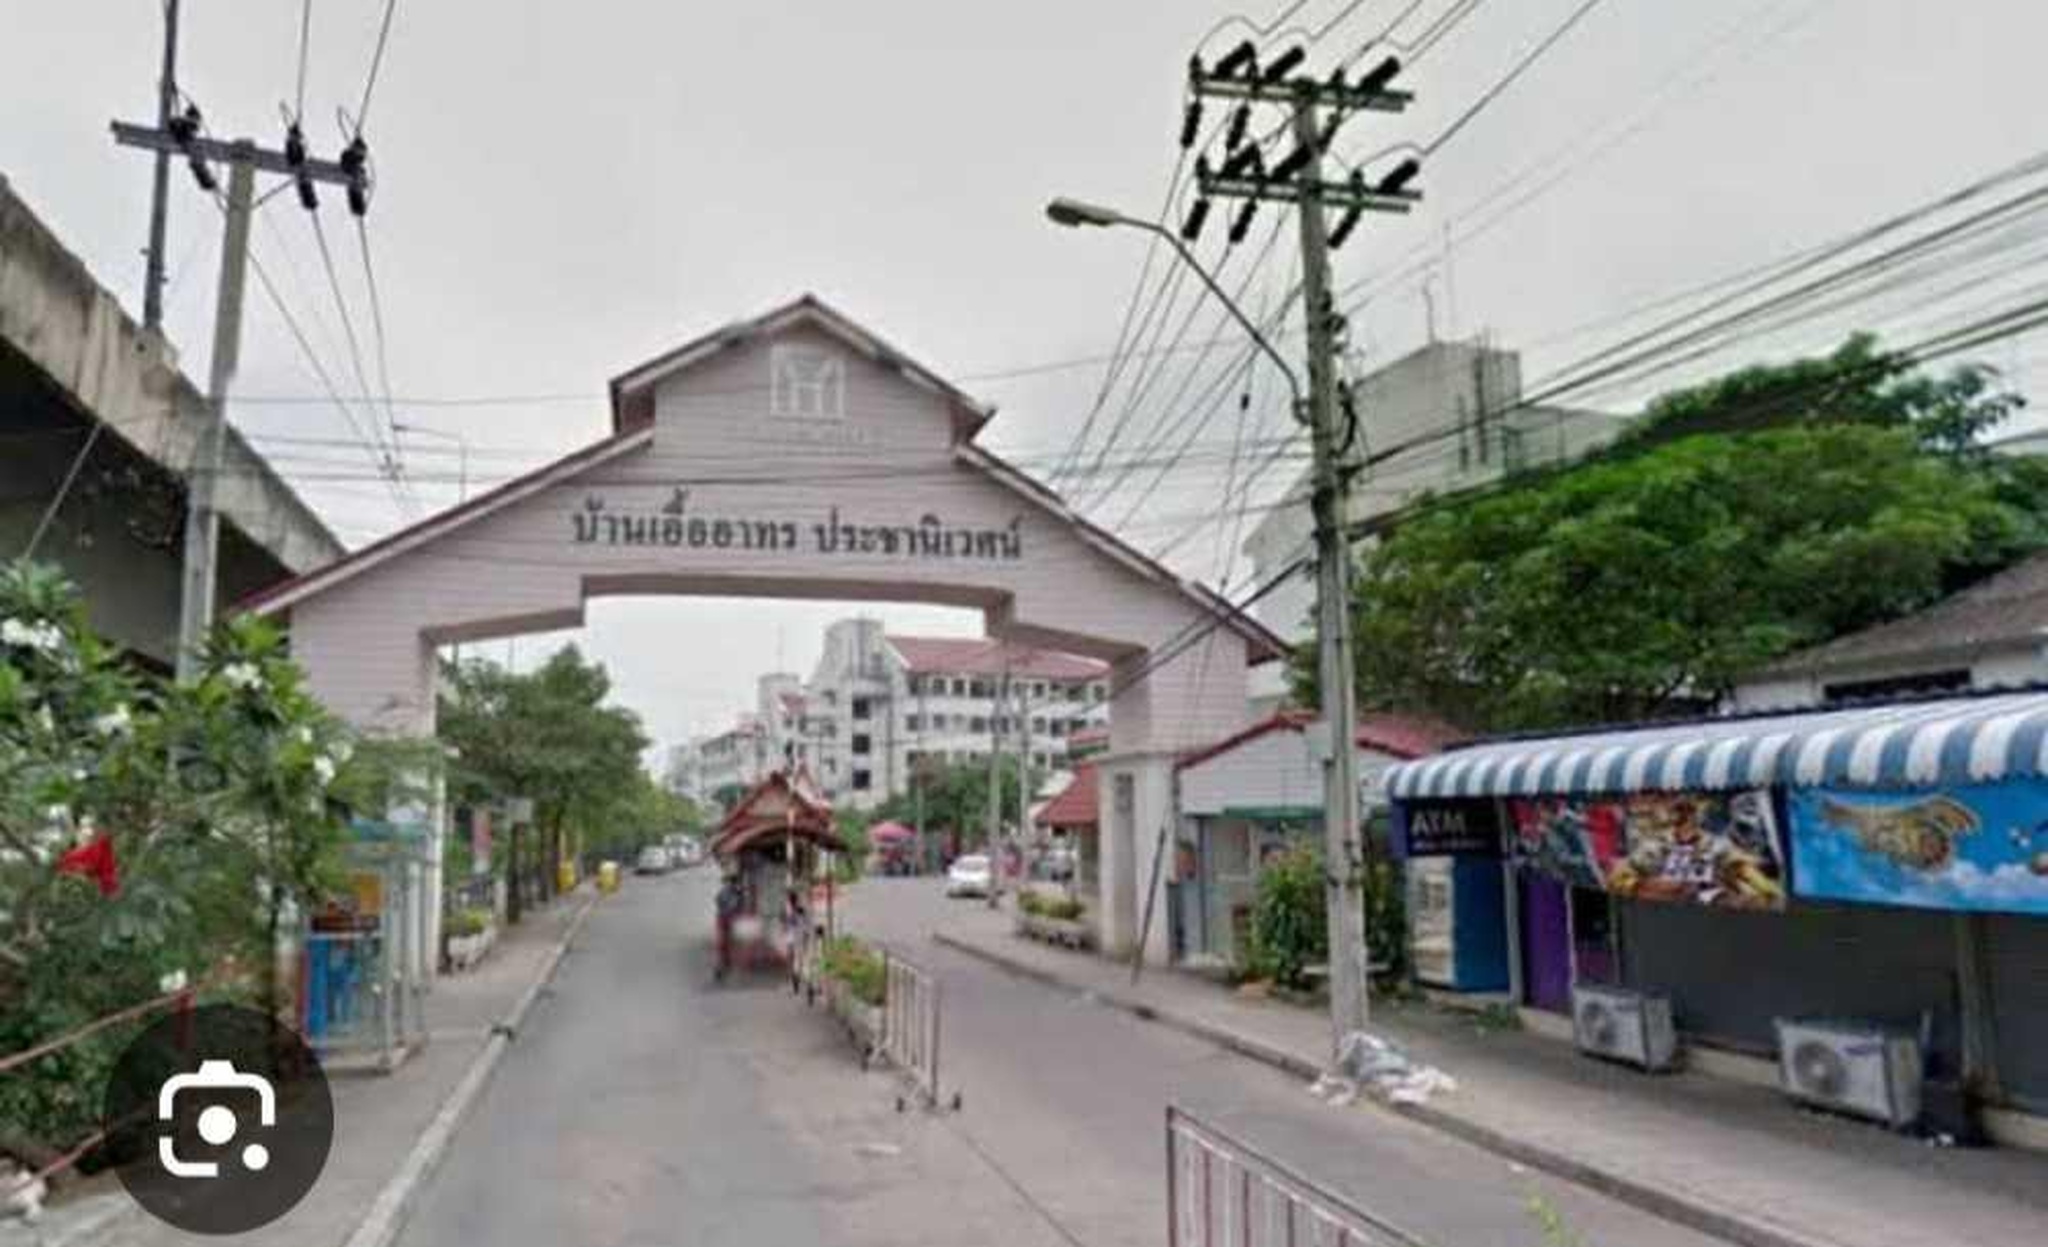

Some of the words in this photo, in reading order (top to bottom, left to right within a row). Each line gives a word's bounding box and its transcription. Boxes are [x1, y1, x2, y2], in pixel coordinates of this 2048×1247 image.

[572, 487, 797, 549] บ้านเอื้ออาทร
[813, 505, 1023, 559] ประชานิเวศน์
[1411, 810, 1466, 835] ATM
